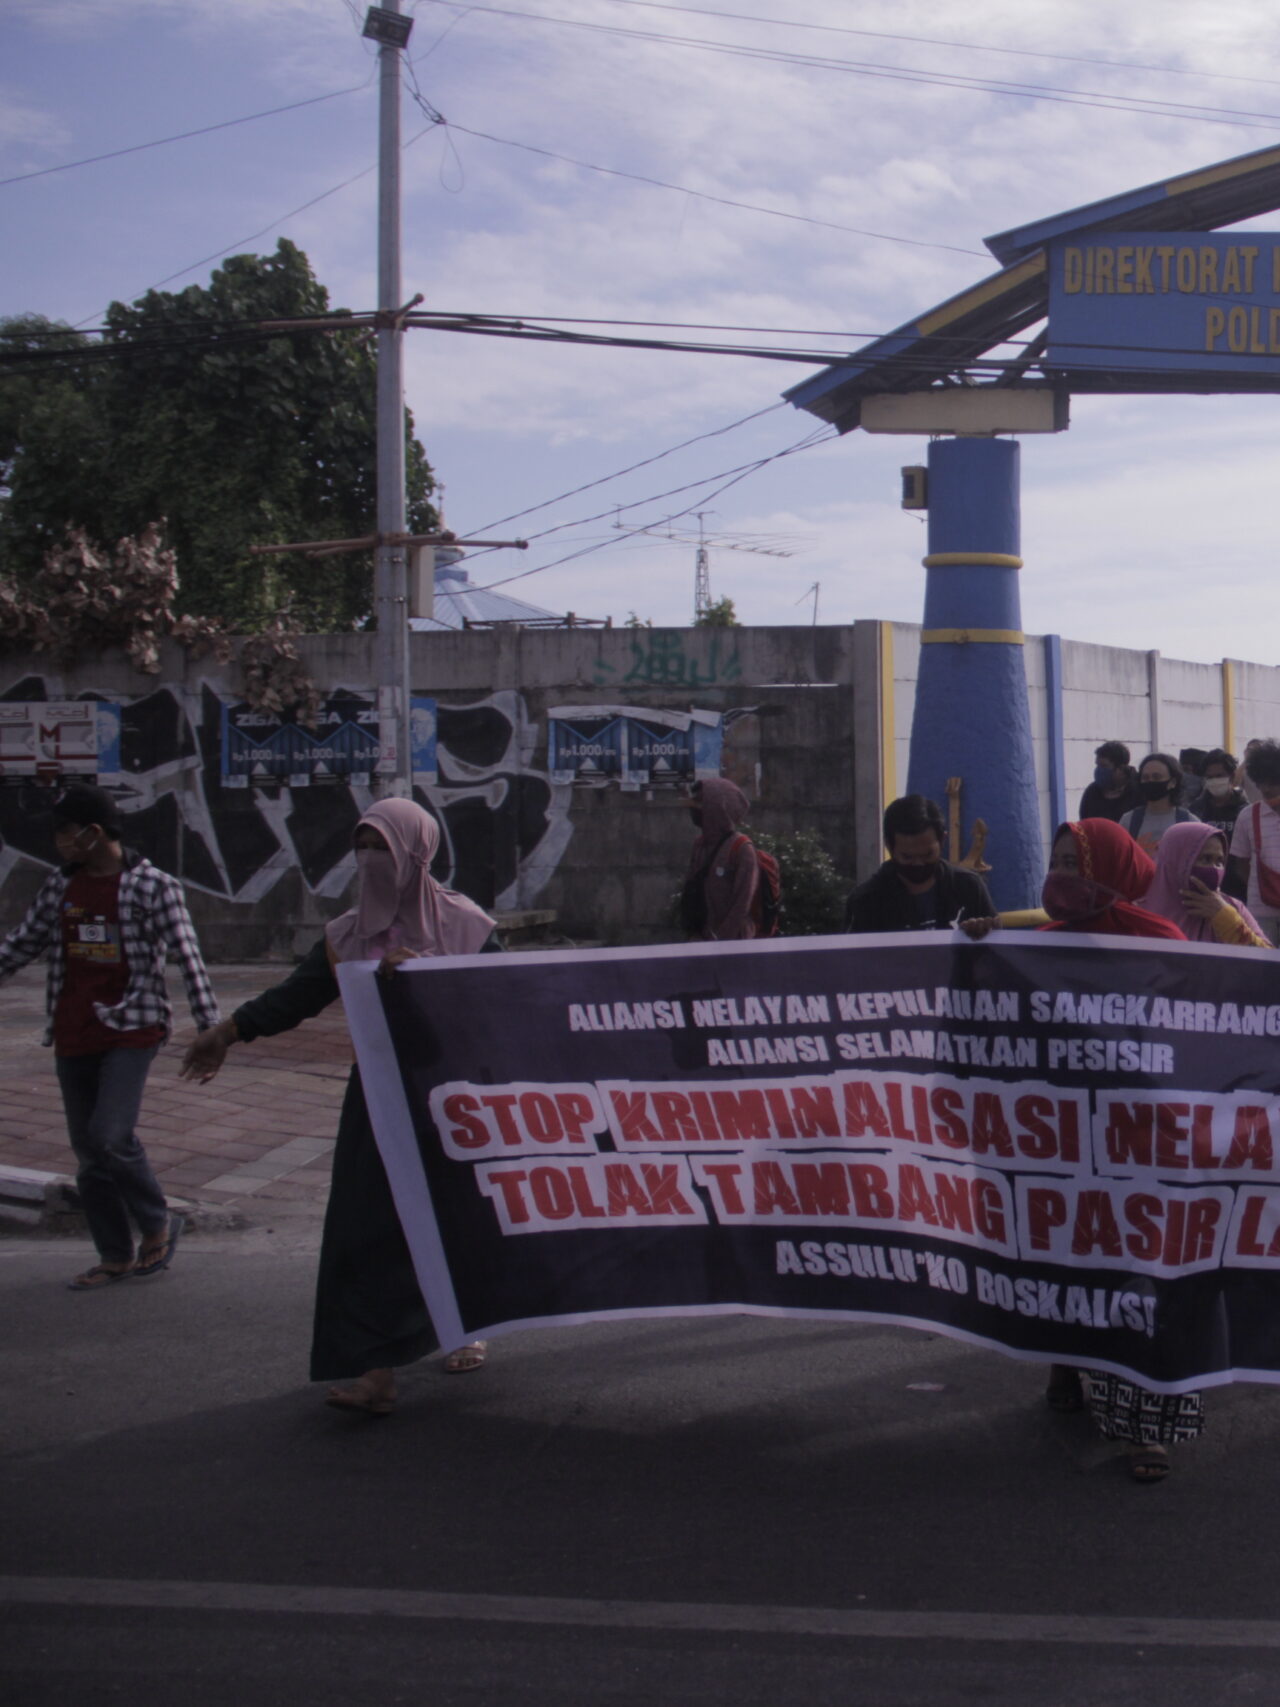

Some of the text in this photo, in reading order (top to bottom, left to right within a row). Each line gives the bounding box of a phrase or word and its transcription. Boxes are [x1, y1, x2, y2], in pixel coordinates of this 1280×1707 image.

[1064, 246, 1258, 294] DIREKTORAT
[235, 713, 282, 727] ZIGA
[568, 1000, 686, 1032] ALIANSI
[692, 994, 832, 1027] NELAYAN
[836, 987, 1019, 1021] KEPULAUAN
[707, 1029, 1175, 1073] ALIANSI SELAMATKAN PESISIR
[443, 1091, 594, 1149] STOP
[609, 1081, 1080, 1164] KRIMINALISASI
[487, 1163, 696, 1225] TOLAK
[703, 1161, 1008, 1246] TAMBANG
[1028, 1188, 1222, 1266] PASIR
[975, 1266, 1158, 1339] BOSKALIS!
